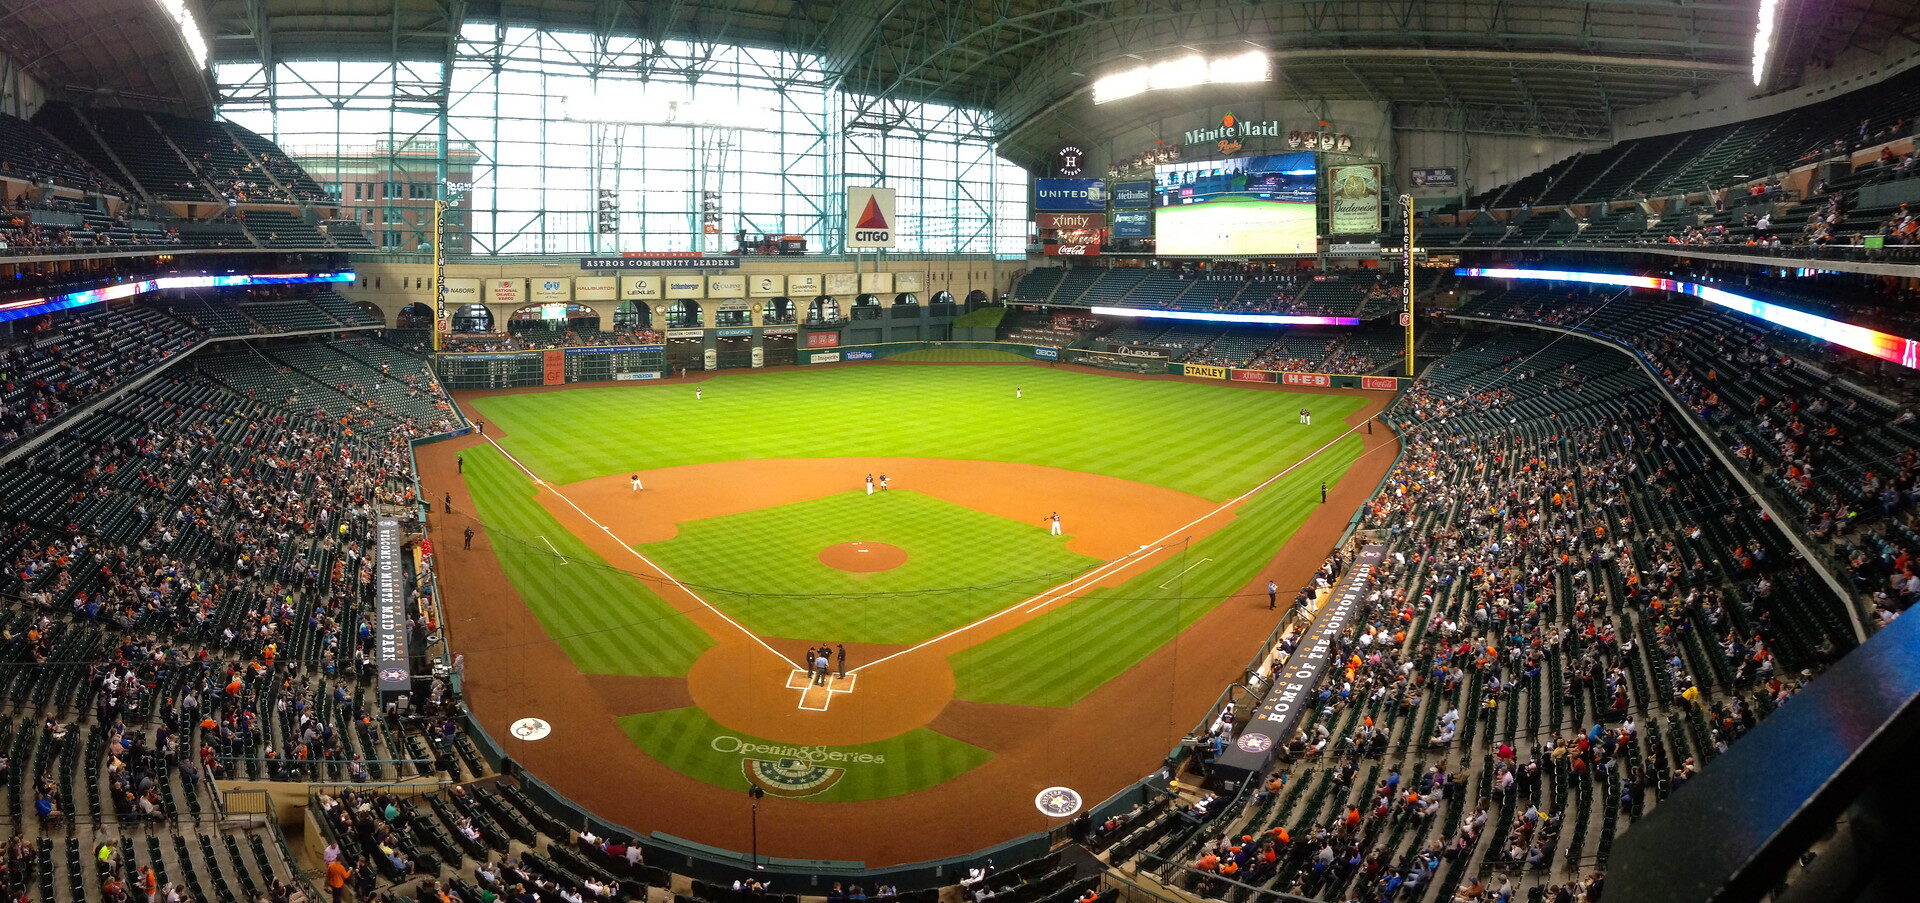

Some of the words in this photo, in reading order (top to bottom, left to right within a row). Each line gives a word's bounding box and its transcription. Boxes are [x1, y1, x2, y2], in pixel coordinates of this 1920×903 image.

[1238, 120, 1279, 137] Maid
[1066, 156, 1076, 167] H
[1039, 190, 1088, 198] UNITED
[1333, 199, 1376, 213] Budweiser
[1053, 214, 1089, 228] xfinity
[855, 231, 889, 242] CITGO
[670, 283, 699, 291] Schlumberger
[437, 285, 446, 319] FARE
[1402, 280, 1410, 312] FOUL
[1035, 349, 1057, 358] GEICO
[1185, 366, 1225, 378] STANLEY
[1242, 371, 1266, 381] xfinity
[1288, 374, 1325, 385] H-E-B
[380, 529, 391, 560] WELCOME
[380, 561, 391, 570] TO
[381, 572, 393, 603] MINUTE
[381, 606, 394, 630] MAID
[382, 634, 396, 662] PARK
[1267, 683, 1304, 723] HOME
[1295, 662, 1316, 679] OF
[1307, 639, 1330, 659] THE
[1323, 599, 1353, 636] HOUSTON
[1258, 665, 1298, 720] WELCOME
[1299, 647, 1311, 658] TO
[710, 735, 809, 760] Opening
[807, 744, 886, 764] Series
